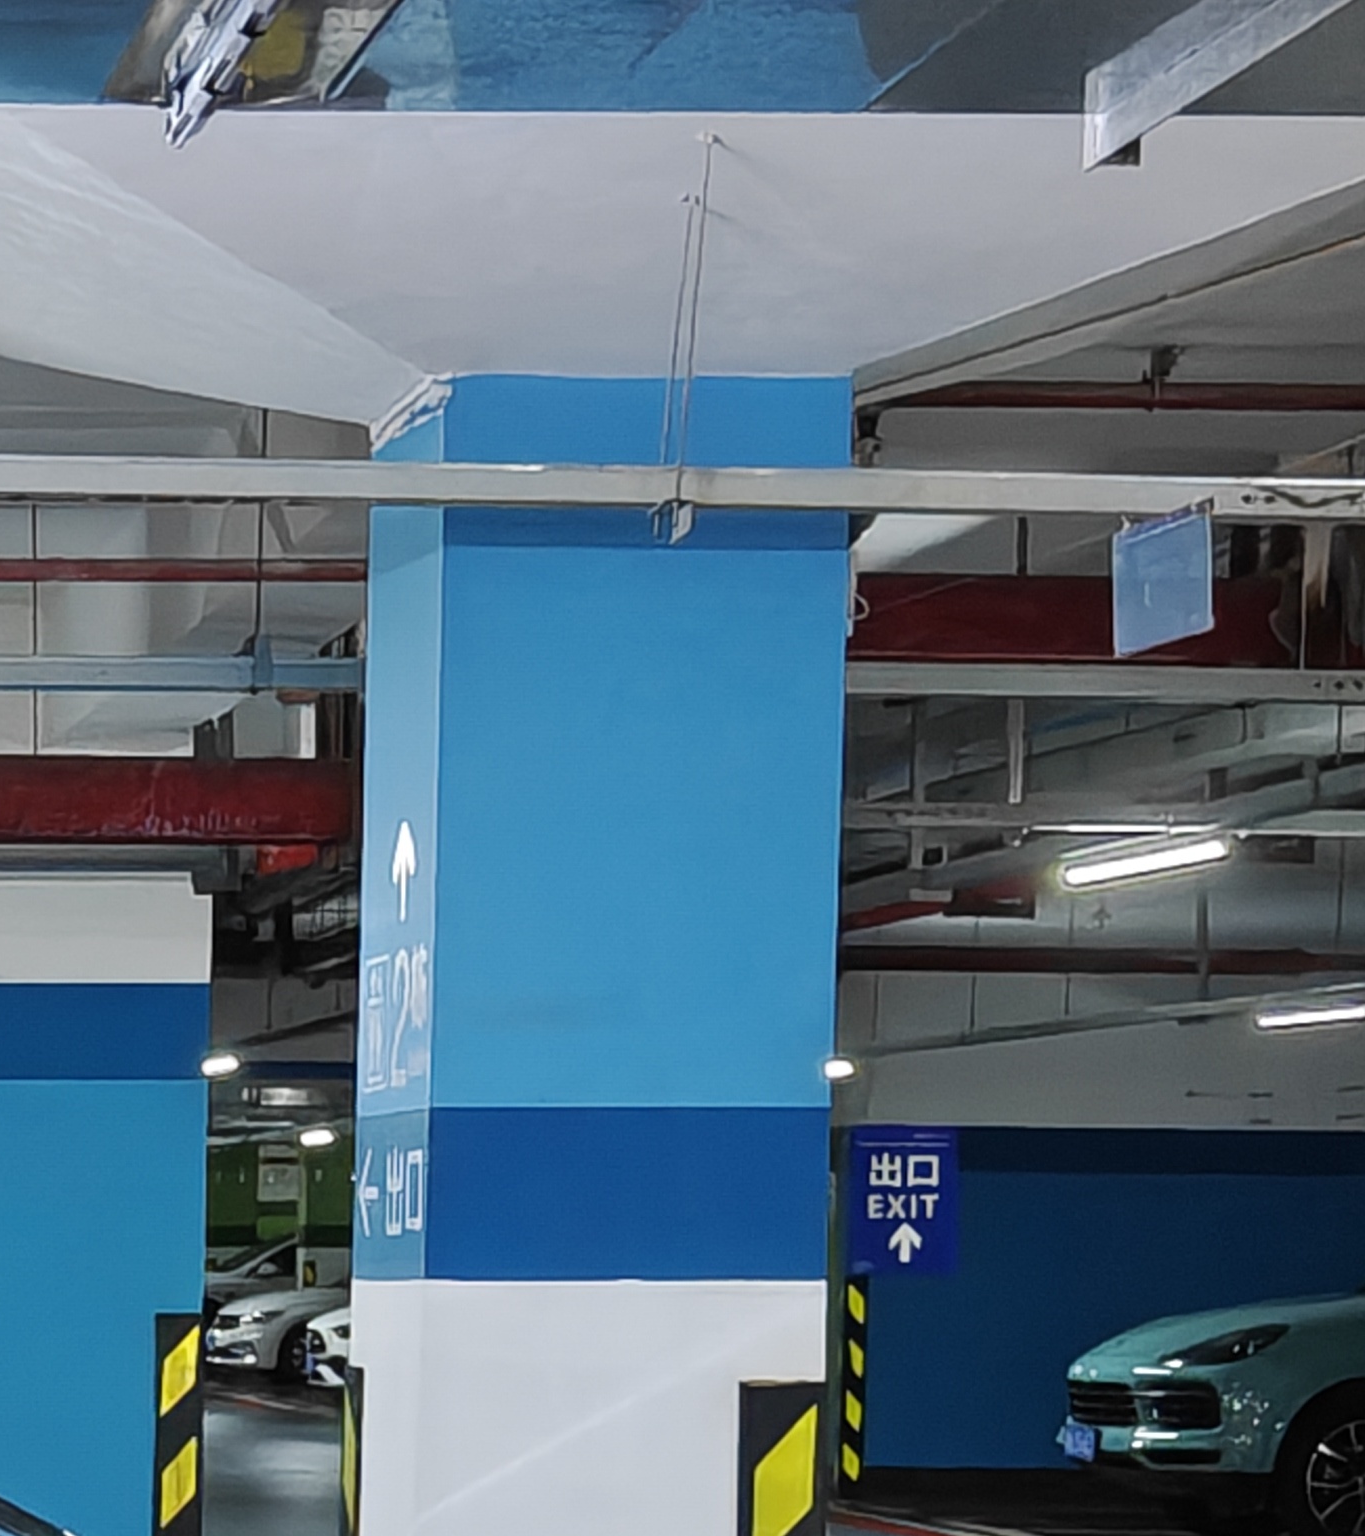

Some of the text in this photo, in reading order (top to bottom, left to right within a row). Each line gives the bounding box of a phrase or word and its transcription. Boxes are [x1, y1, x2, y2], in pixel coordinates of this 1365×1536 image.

[869, 1152, 940, 1188] 出口
[385, 1144, 424, 1237] 出口
[867, 1193, 940, 1220] EXIT
